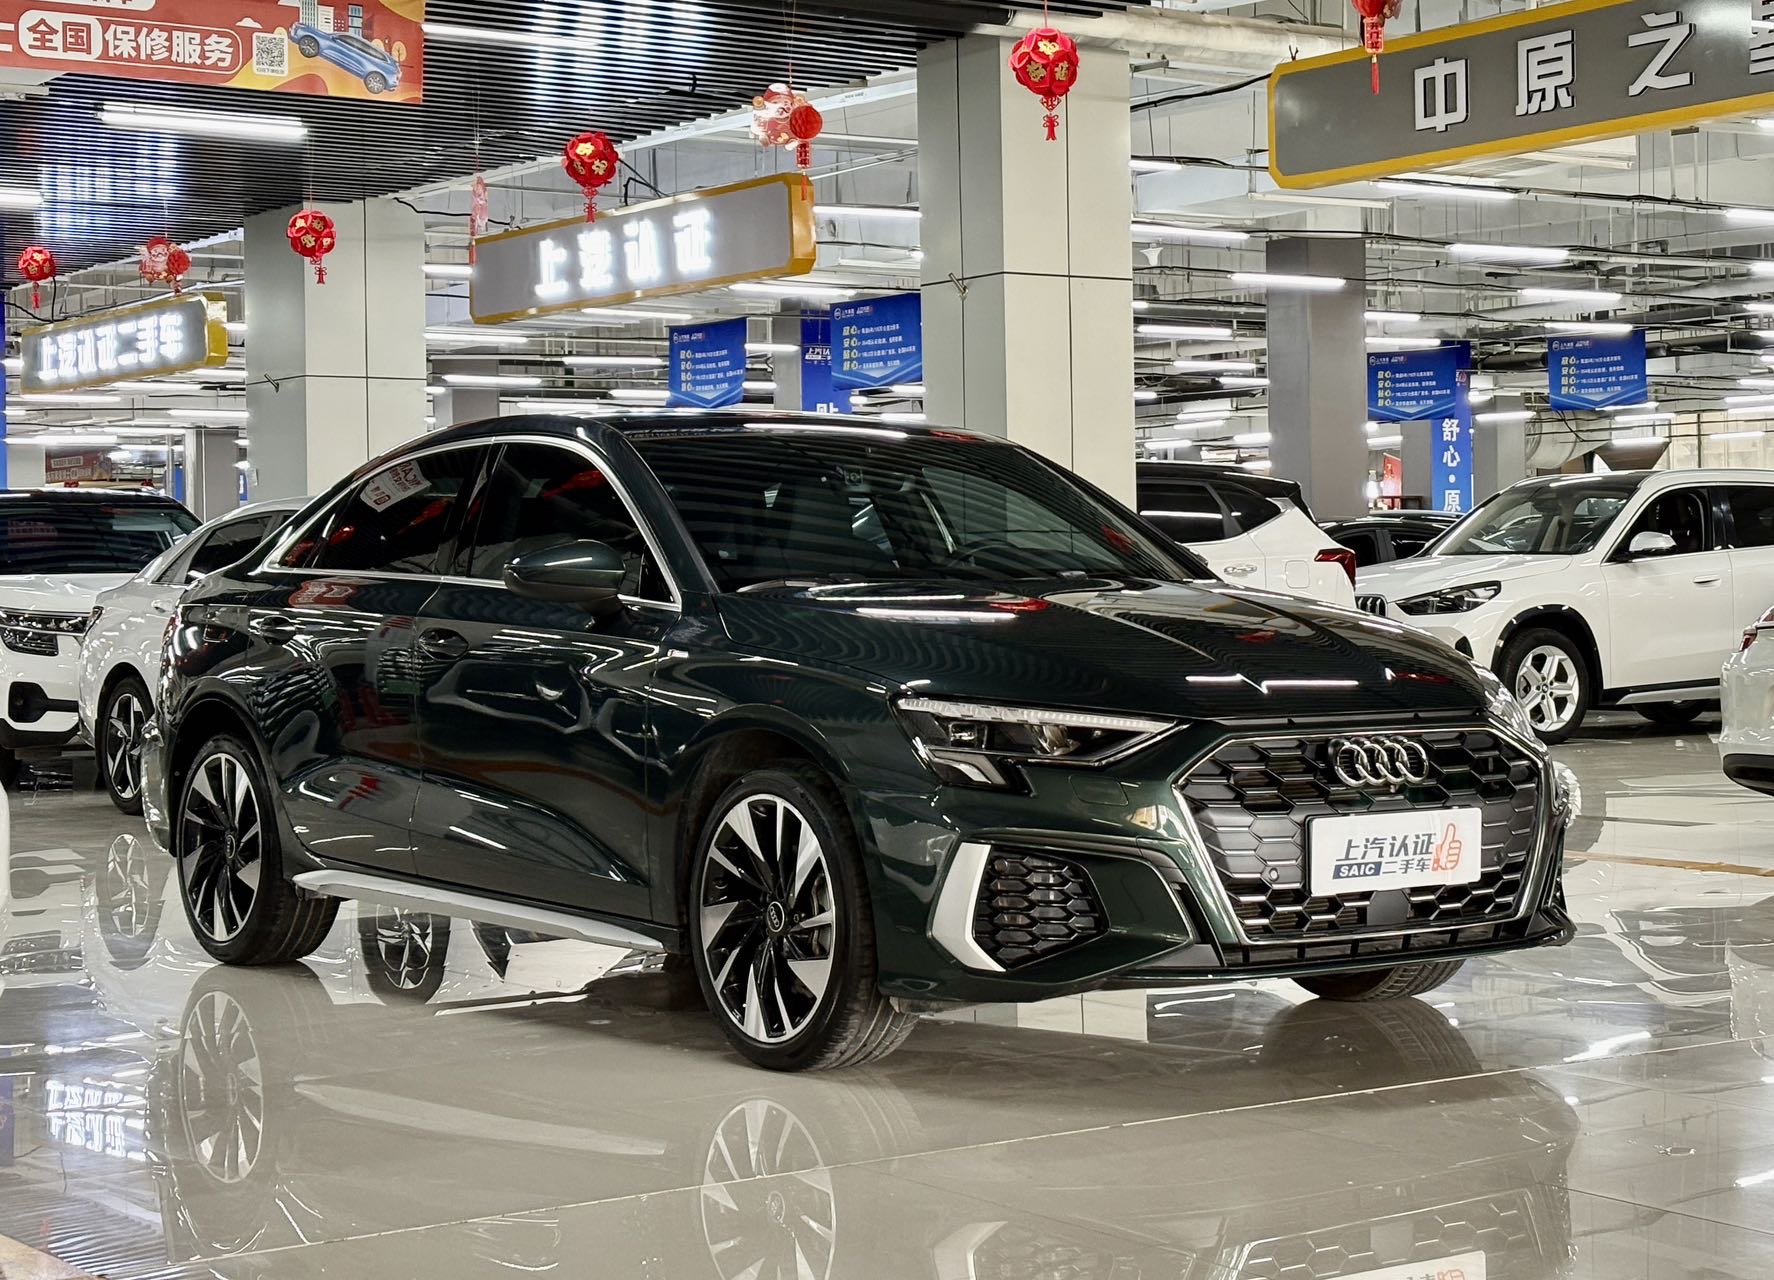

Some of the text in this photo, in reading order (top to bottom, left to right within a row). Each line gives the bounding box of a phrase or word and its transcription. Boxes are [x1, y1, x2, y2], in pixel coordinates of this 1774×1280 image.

[27, 18, 233, 67] 全国保修服务
[1336, 832, 1436, 861] 上汽认证
[1339, 857, 1431, 877] SAIC 二手车
